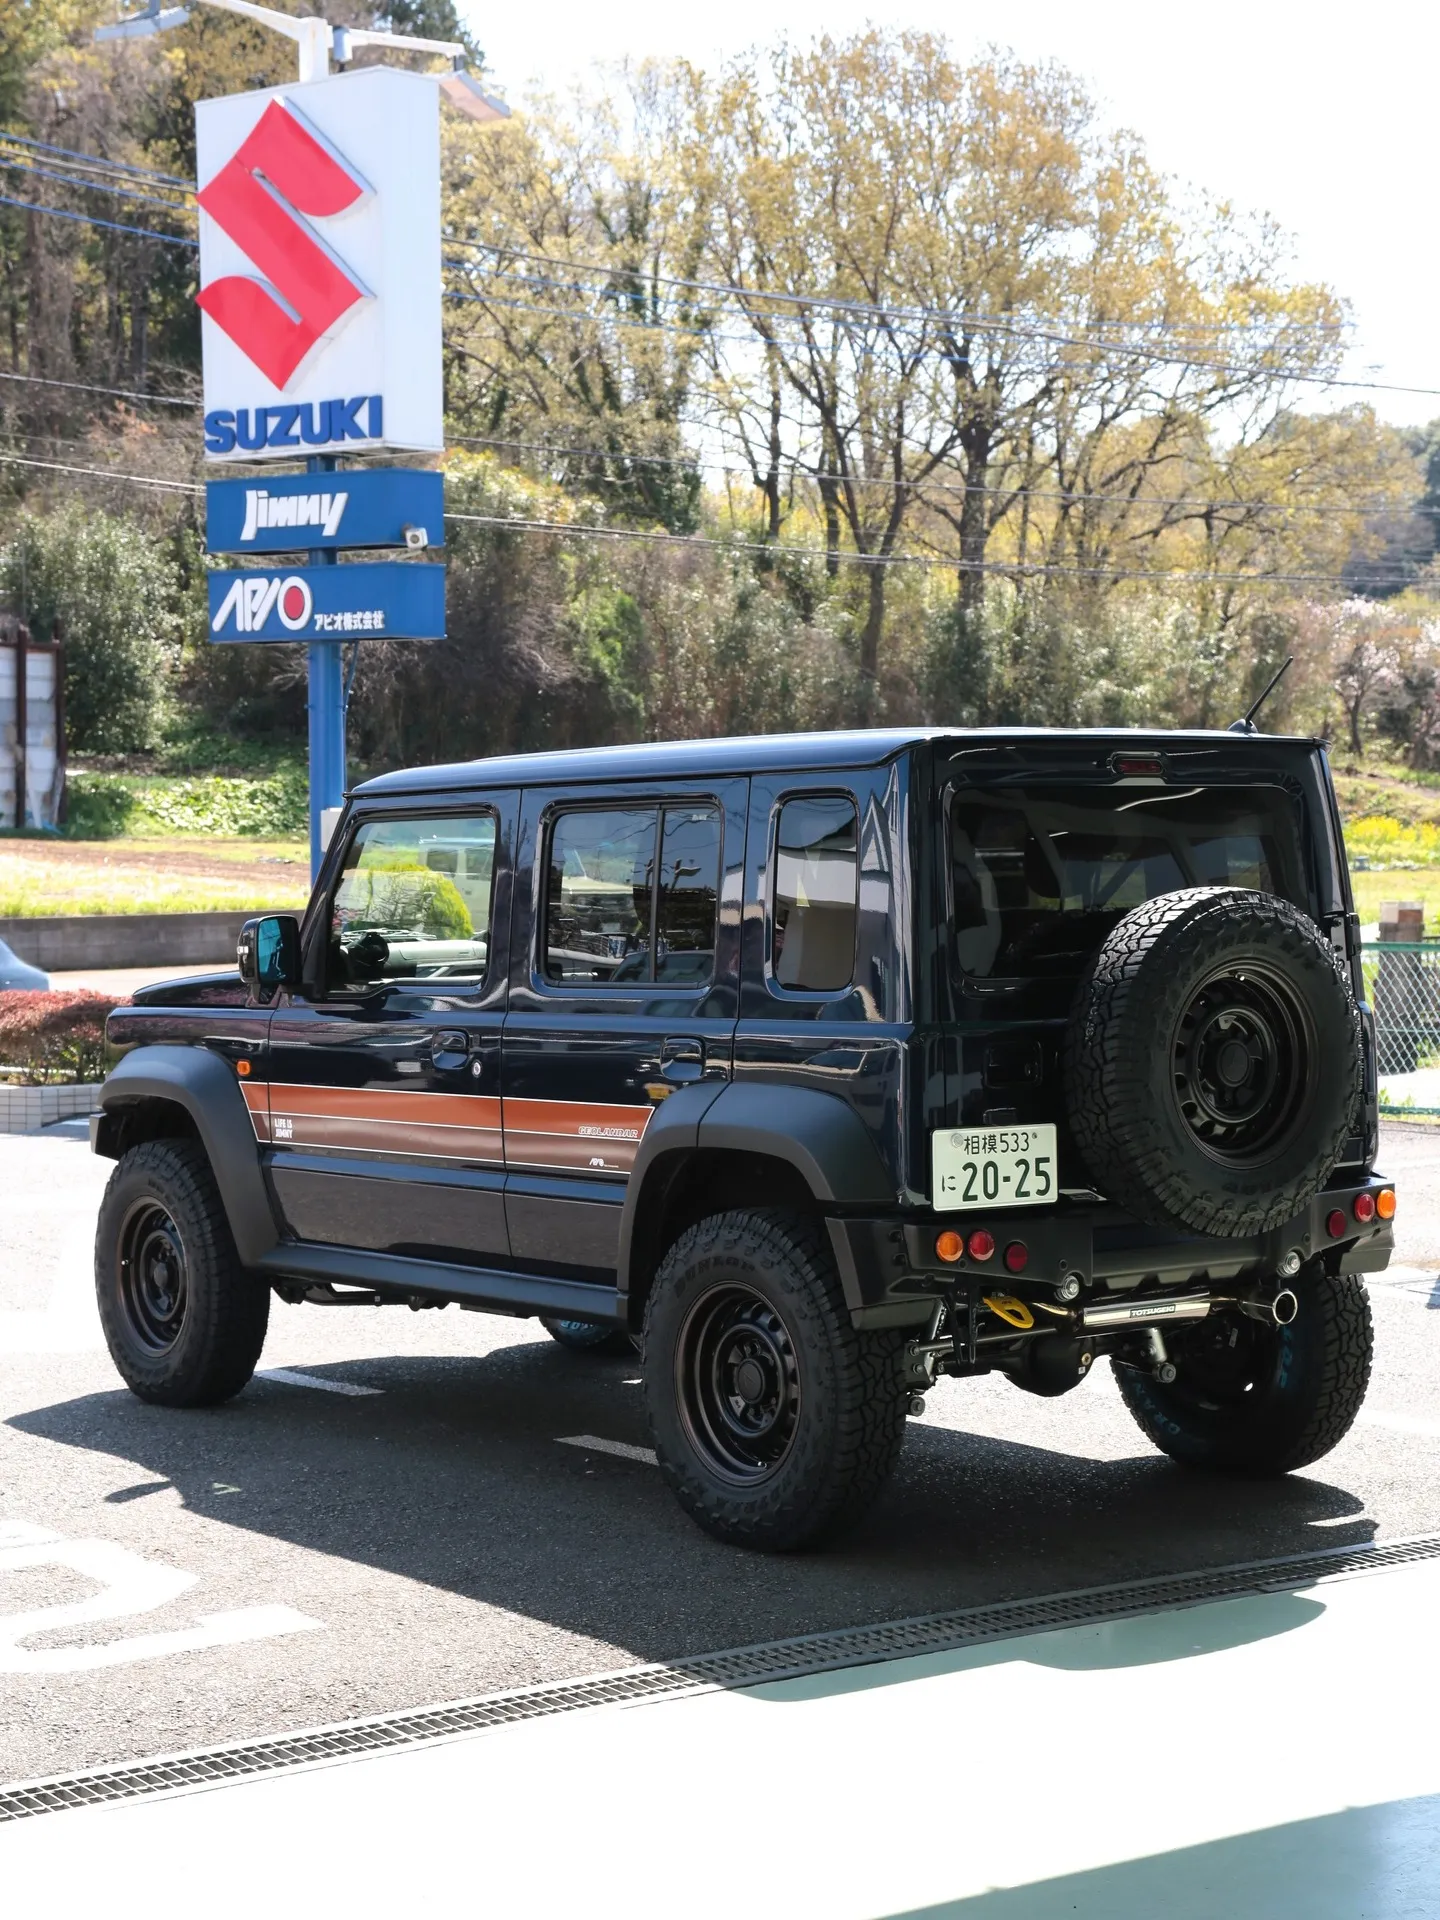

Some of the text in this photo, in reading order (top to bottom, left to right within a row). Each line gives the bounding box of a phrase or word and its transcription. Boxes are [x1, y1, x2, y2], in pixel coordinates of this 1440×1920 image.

[204, 395, 383, 454] SUZUKI
[274, 1119, 293, 1128] LIFE IS
[578, 1125, 639, 1138] GEOLANDAR
[964, 1132, 1030, 1155] 相模 533
[941, 1156, 1051, 1202] に 20-25
